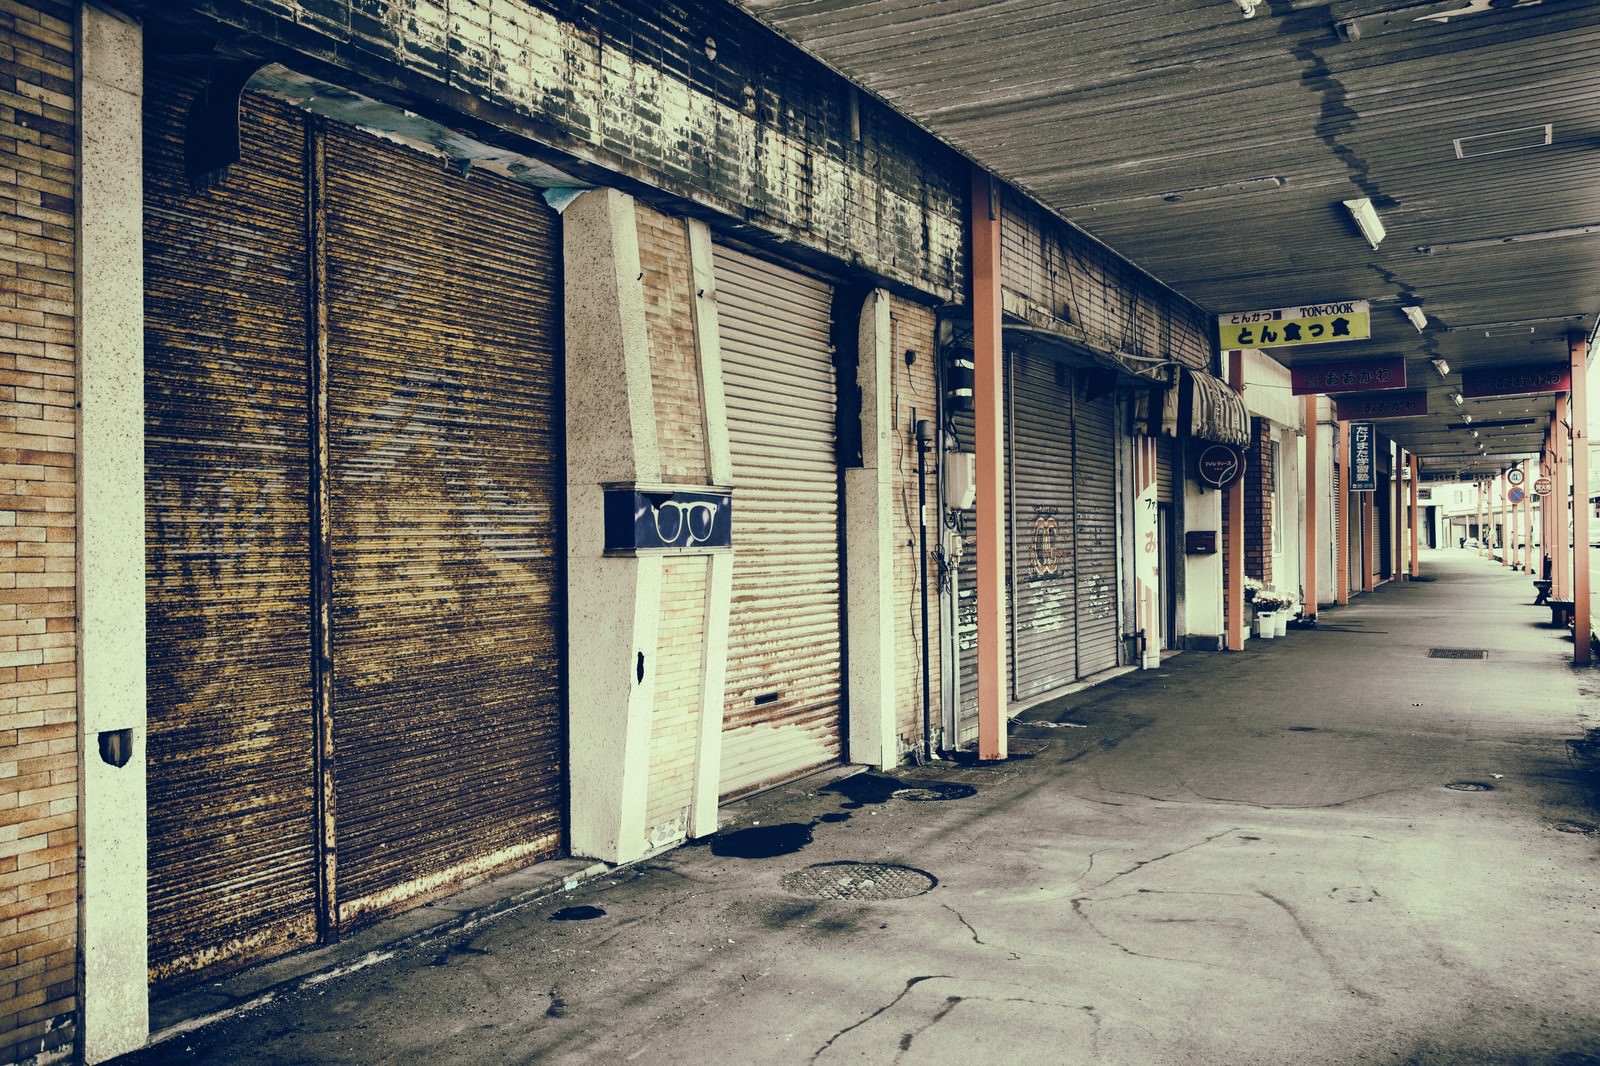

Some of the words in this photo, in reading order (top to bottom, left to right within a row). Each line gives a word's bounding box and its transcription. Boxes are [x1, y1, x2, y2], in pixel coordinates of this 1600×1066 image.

[1300, 302, 1355, 318] TON-COOK
[1325, 367, 1392, 386] おおかわ
